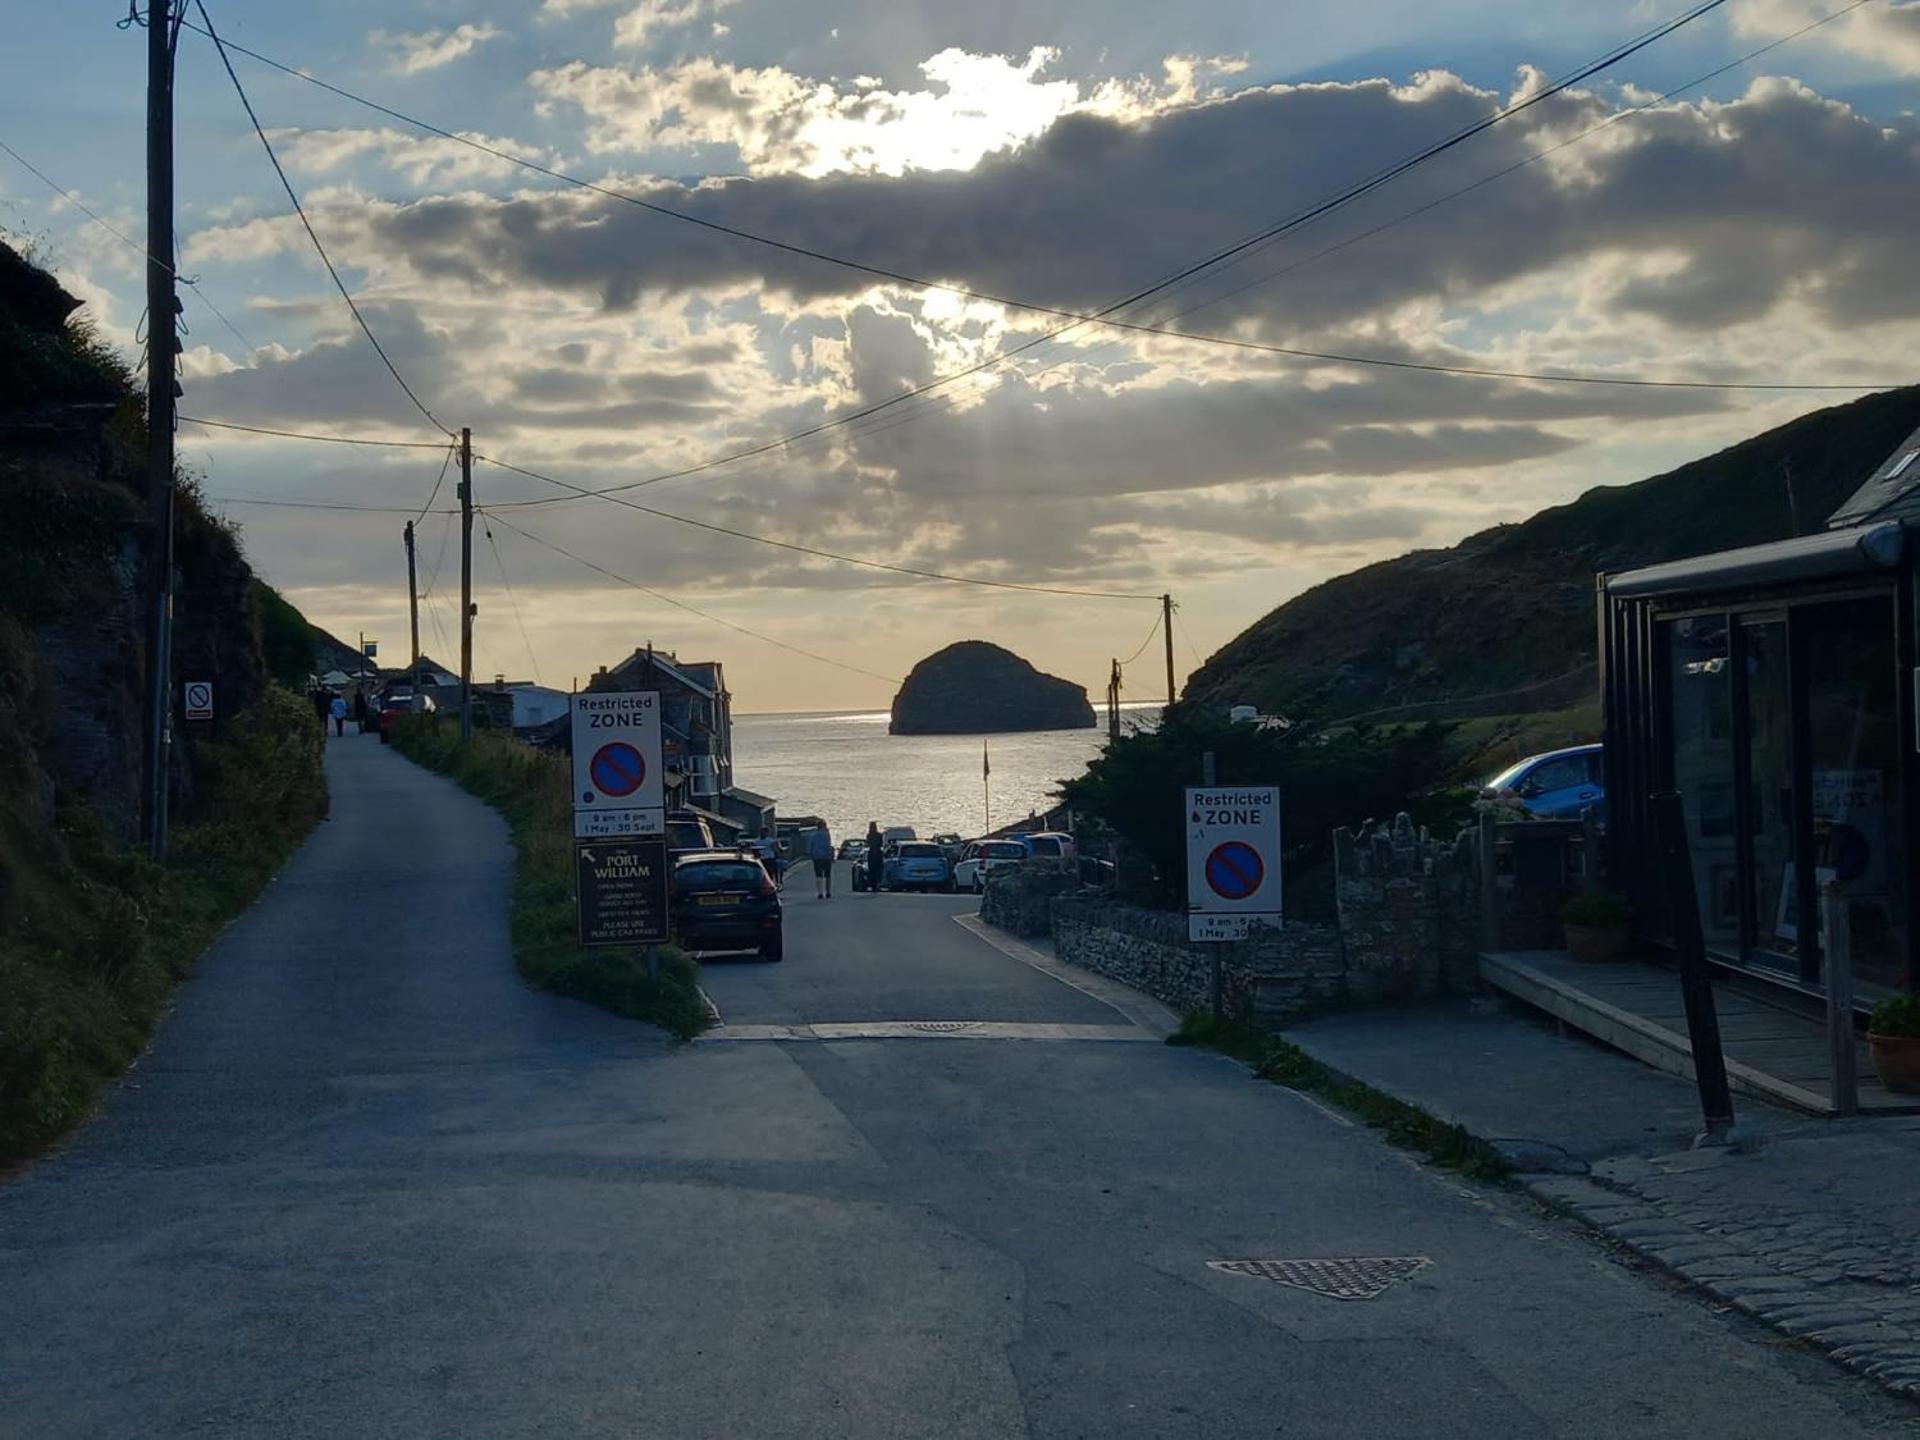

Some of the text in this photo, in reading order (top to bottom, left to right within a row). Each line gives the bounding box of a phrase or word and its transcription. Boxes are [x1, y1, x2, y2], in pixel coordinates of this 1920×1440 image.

[578, 696, 652, 711] Restricted
[590, 712, 643, 728] ZONE
[1194, 792, 1271, 806] Restricted
[1206, 809, 1261, 825] ZONE
[590, 824, 609, 833] May
[617, 823, 631, 832] 30
[633, 823, 656, 832] Sept
[607, 854, 639, 866] PORT
[594, 865, 650, 879] WILLIAM
[1206, 929, 1224, 938] May
[1234, 928, 1248, 937] 30
